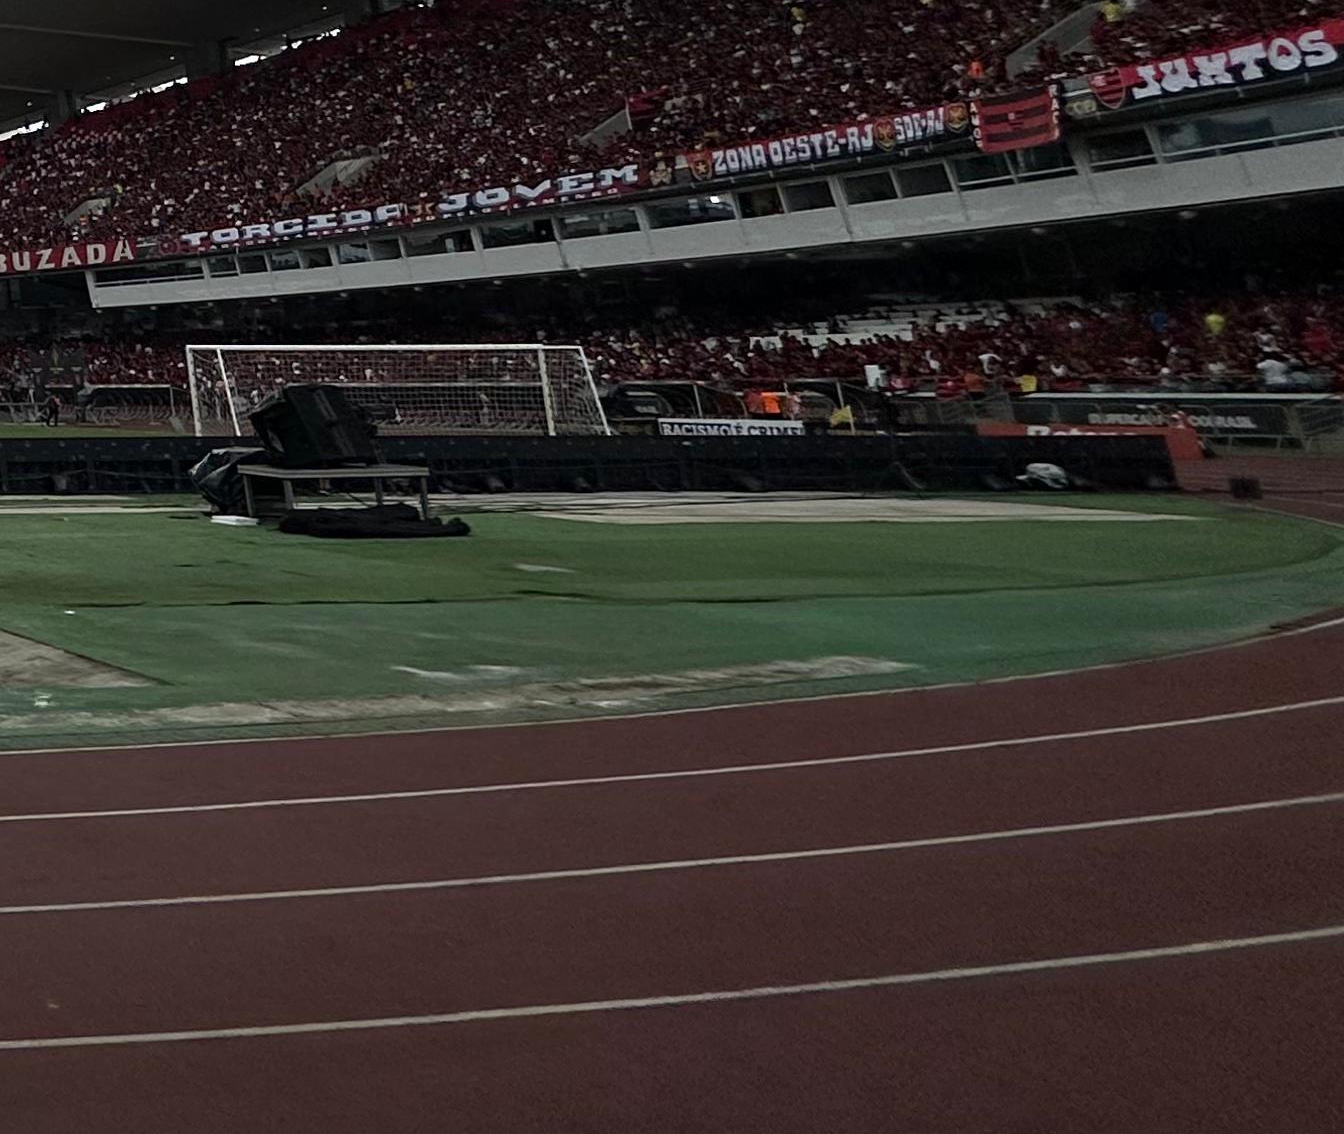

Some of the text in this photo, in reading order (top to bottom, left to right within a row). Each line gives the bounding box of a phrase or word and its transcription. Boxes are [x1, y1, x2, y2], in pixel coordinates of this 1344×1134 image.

[1132, 29, 1339, 101] JUNTOS
[712, 143, 768, 176] ZONA
[180, 163, 640, 247] TORCIDA JOVEM
[661, 423, 731, 436] RACISMO
